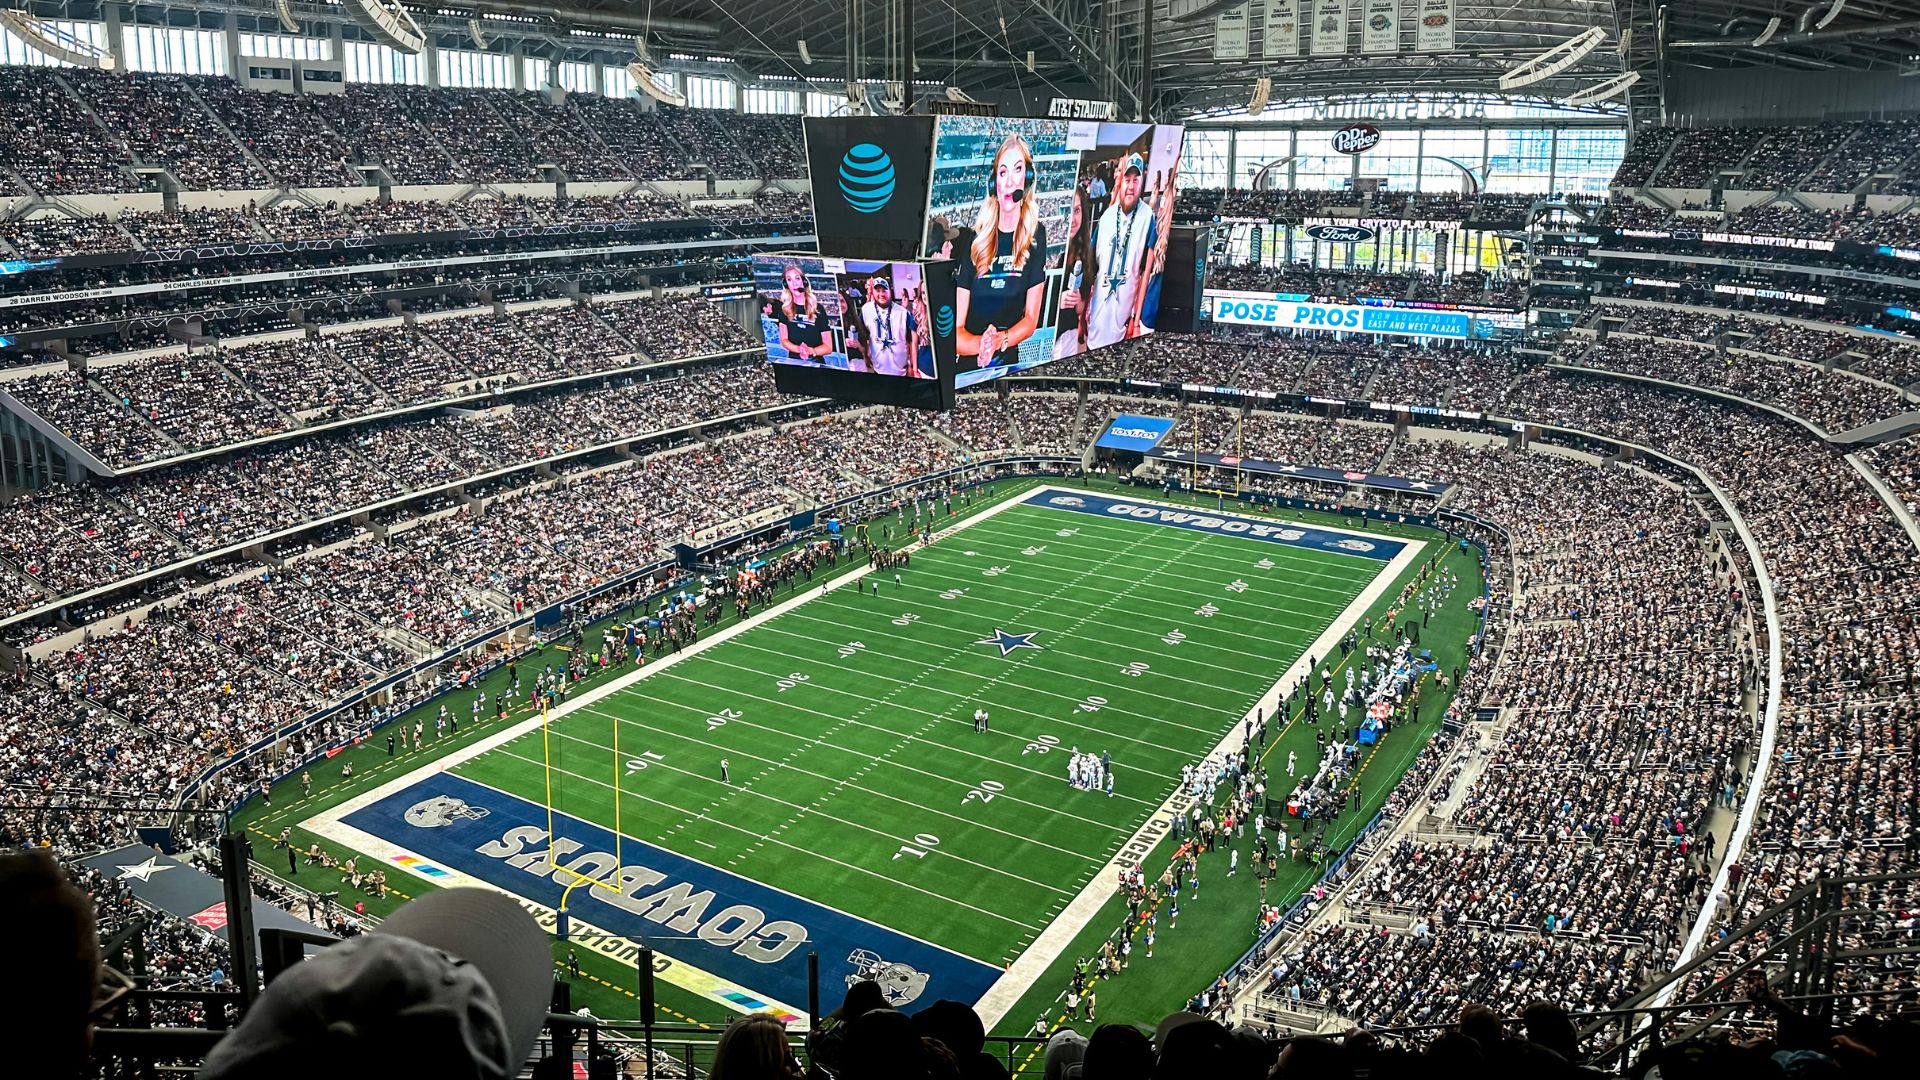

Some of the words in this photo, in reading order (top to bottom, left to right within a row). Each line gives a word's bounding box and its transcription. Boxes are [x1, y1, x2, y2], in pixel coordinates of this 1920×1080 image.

[1048, 97, 1073, 118] AT&T
[1073, 99, 1113, 120] STADIUM
[1334, 130, 1379, 152] Pepper
[1350, 128, 1368, 140] Dr
[1220, 215, 1269, 224] Blockchain.com
[1304, 217, 1332, 226] MAKE
[1332, 217, 1359, 227] YOUR
[1360, 218, 1399, 229] CRYPTO
[1401, 219, 1428, 229] PLAY
[1428, 220, 1462, 230] TODAY
[1319, 226, 1361, 242] Ford
[1622, 228, 1670, 239] Blockchain.com
[1702, 232, 1729, 243] MAKE
[1729, 233, 1751, 245] YOUR
[1752, 235, 1786, 247] CRYPTO
[1786, 238, 1807, 249] PLAY
[1808, 240, 1836, 252] TODAY
[319, 268, 333, 276] IRVIN
[172, 280, 201, 289] CHARLES
[201, 279, 221, 287] HALEY
[712, 286, 754, 295] Blockchain.com
[1632, 277, 1680, 288] Blockchain.com
[20, 295, 51, 304] DARREN
[52, 292, 89, 301] WOODSON
[1714, 284, 1736, 294] MAKE
[1736, 285, 1756, 296] YOUR
[1756, 287, 1786, 299] CRYPTO
[1786, 291, 1804, 302] PLAY
[1804, 293, 1826, 305] TODAY
[1218, 301, 1279, 322] POSE
[1293, 306, 1360, 327] PROS
[1370, 311, 1390, 320] NOW
[1395, 313, 1440, 324] LOCATED
[1446, 316, 1457, 325] IN
[1368, 319, 1388, 328] EAST
[1389, 321, 1405, 330] AND
[1408, 322, 1428, 331] WEST
[1431, 323, 1461, 334] PLAZAS
[1215, 386, 1240, 396] CRYPTO
[1370, 401, 1391, 411] MAKE
[1391, 403, 1409, 412] YOUR
[1410, 405, 1438, 415] CRYPTO
[1438, 409, 1457, 418] PLAY
[1457, 411, 1481, 420] TODAY
[1106, 503, 1307, 541] COWBOYS
[1254, 559, 1275, 569] 10
[1225, 581, 1249, 593] 20
[1194, 604, 1219, 617] 30
[891, 612, 921, 626] 50
[1161, 631, 1187, 645] 40
[837, 641, 866, 655] 40
[1120, 661, 1150, 677] 50
[776, 672, 810, 688] 30
[1079, 696, 1109, 712] 40
[706, 708, 744, 726] 20
[1026, 734, 1060, 754] 30
[625, 750, 666, 770] 10
[967, 780, 1005, 804] 20
[899, 833, 940, 859] 10
[1113, 819, 1170, 869] CANCER
[475, 825, 809, 965] COWBOYS
[567, 919, 673, 974] CUCIAL
